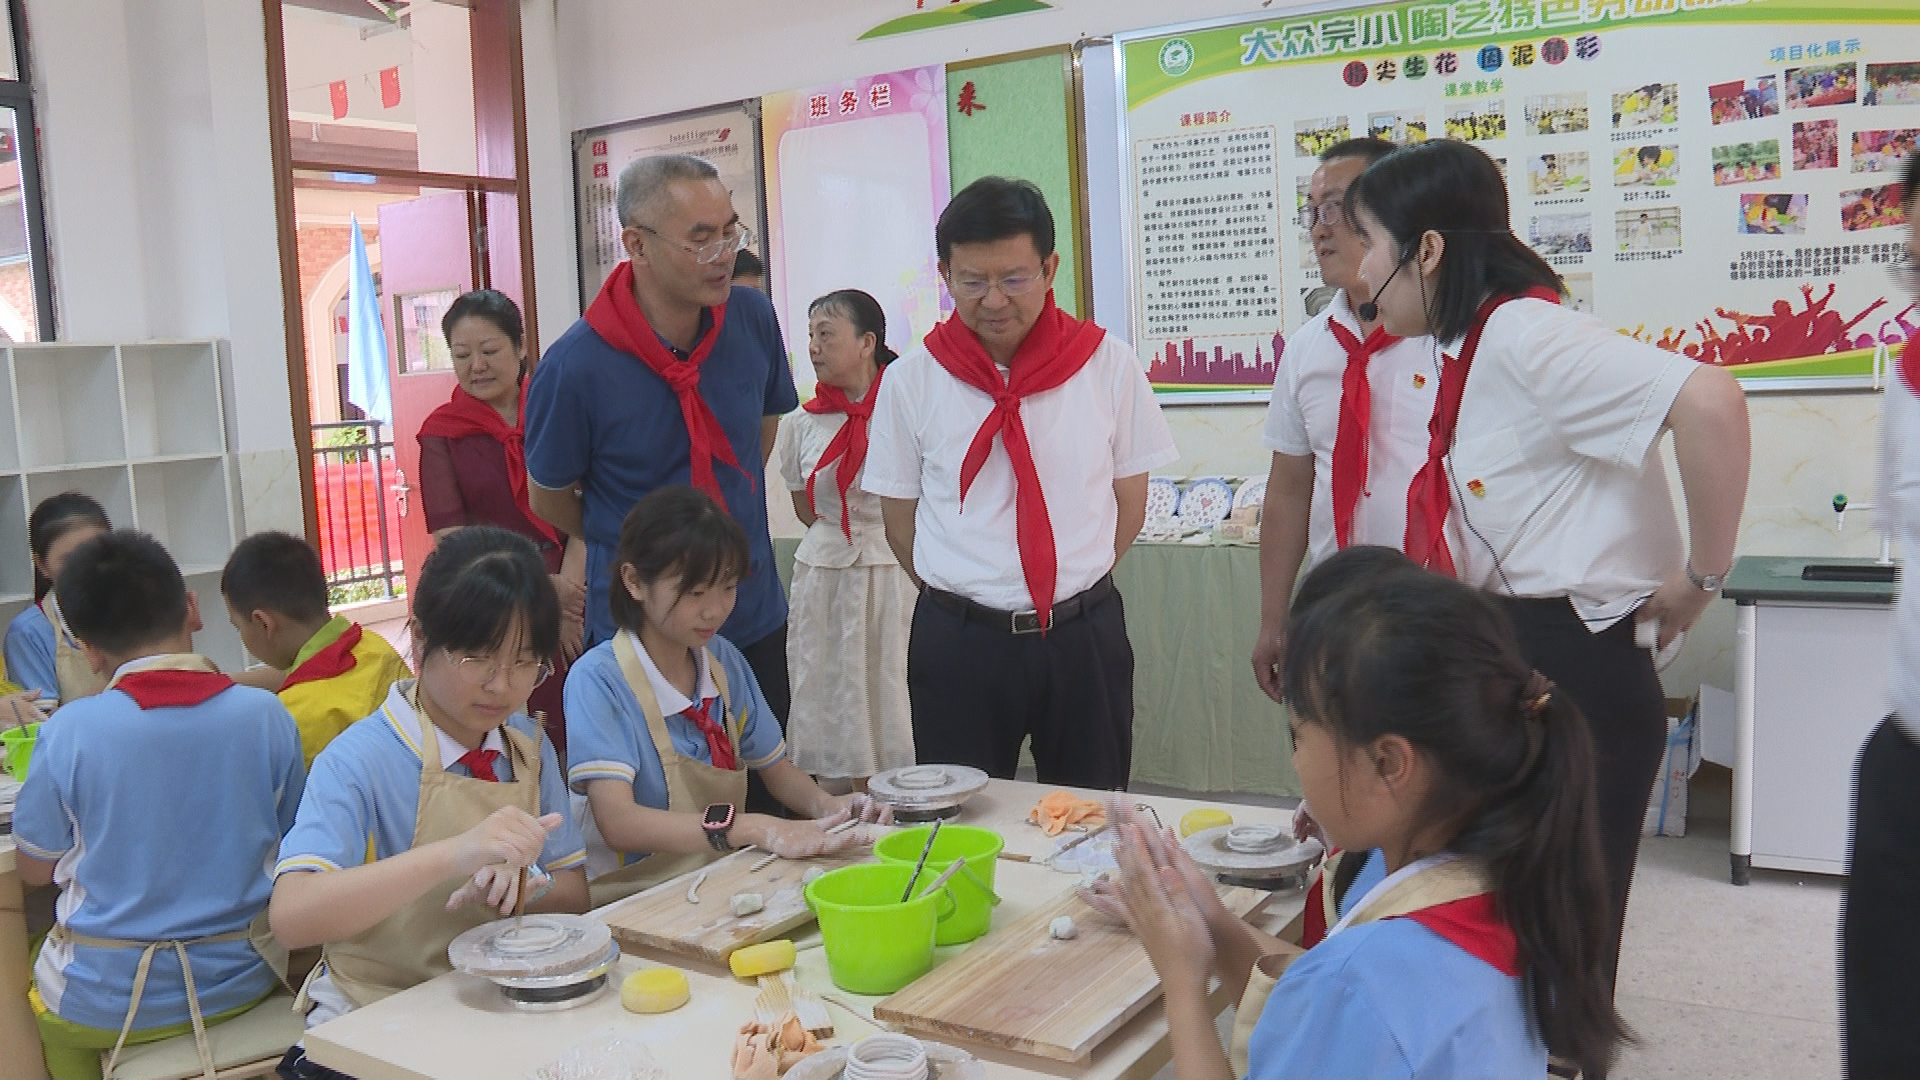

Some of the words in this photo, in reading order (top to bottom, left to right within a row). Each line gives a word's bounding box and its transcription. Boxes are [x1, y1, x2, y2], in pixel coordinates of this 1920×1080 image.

[1243, 14, 1400, 62] 大众完小
[1769, 38, 1861, 62] 项目化展示
[1444, 78, 1503, 96] 课堂教学
[810, 85, 889, 117] 班务栏
[1180, 109, 1231, 126] 课程简介
